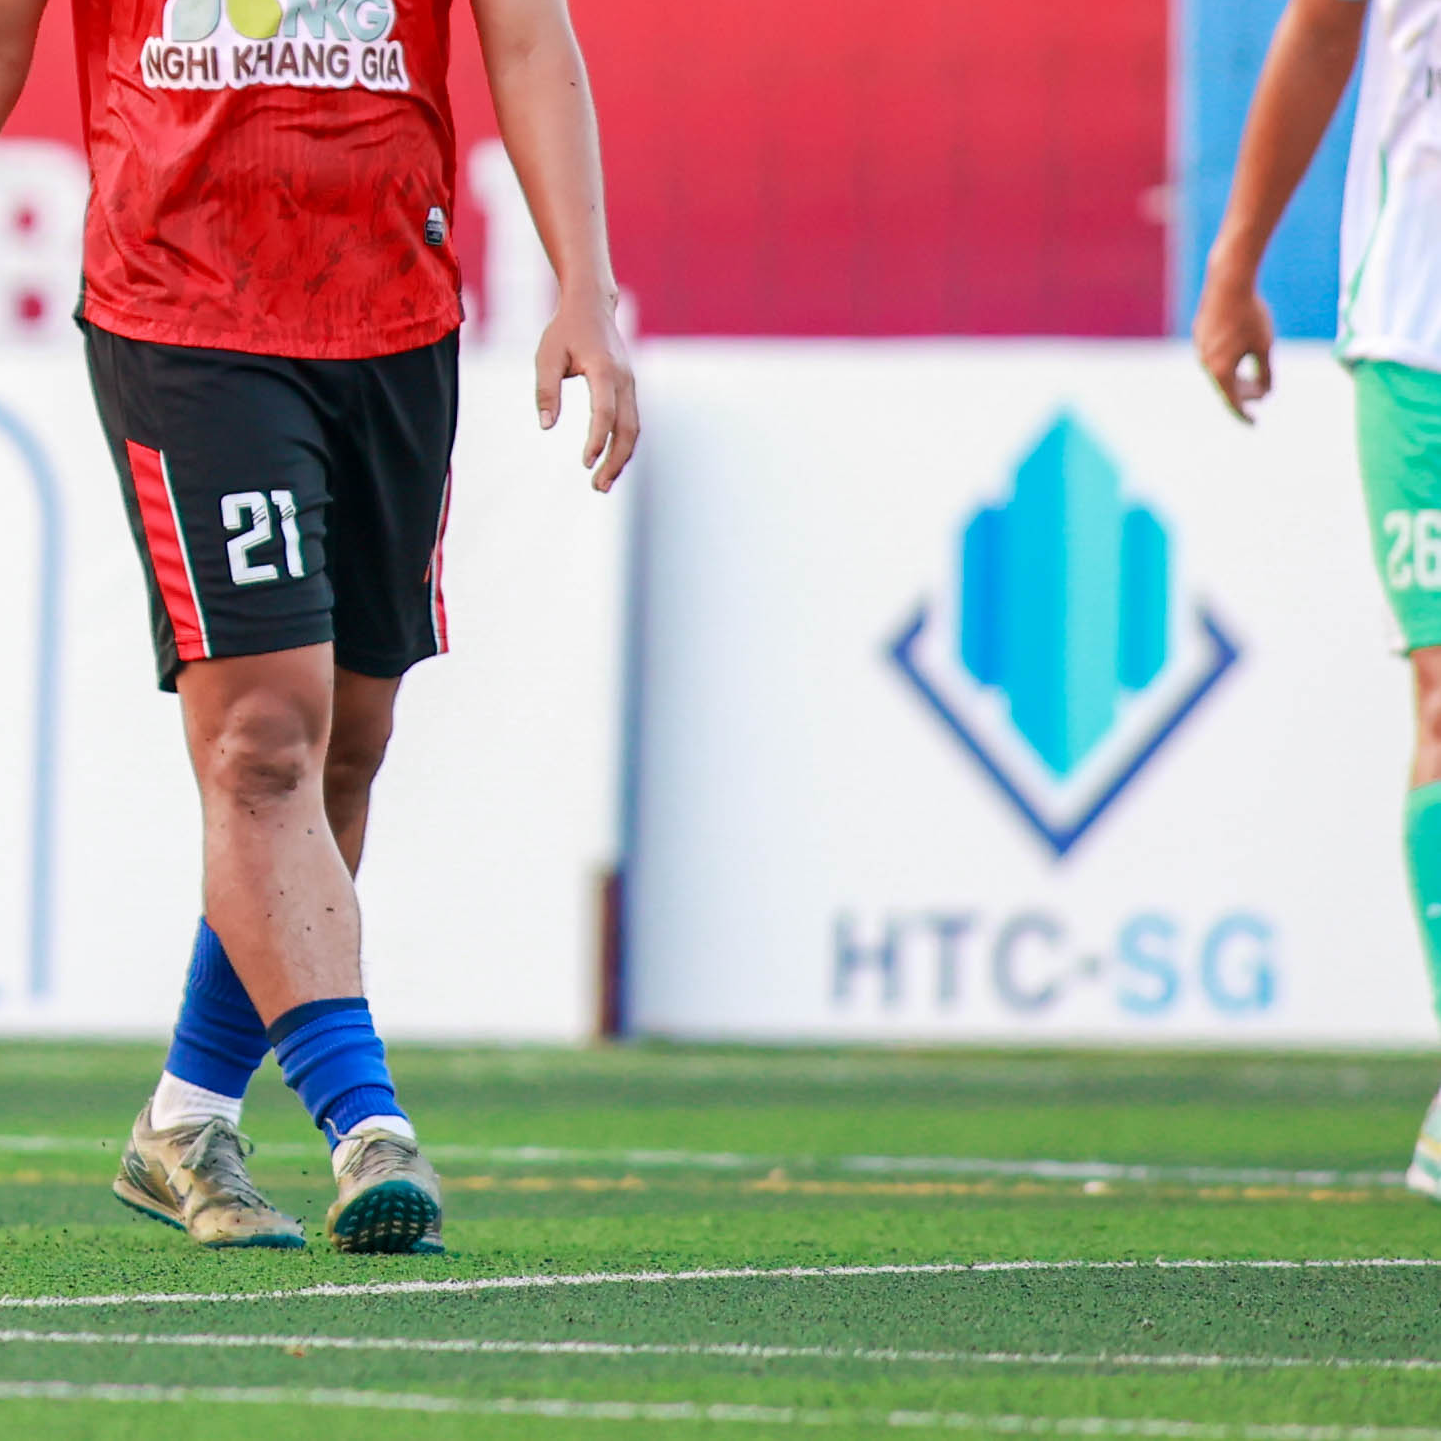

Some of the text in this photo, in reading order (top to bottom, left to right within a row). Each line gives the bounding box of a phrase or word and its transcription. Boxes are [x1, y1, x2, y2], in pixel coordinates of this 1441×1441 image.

[145, 40, 405, 83] NGHI KHANG GIA
[220, 489, 305, 586] 21
[1383, 508, 1441, 591] 26
[829, 906, 1282, 1018] HTC-SG
